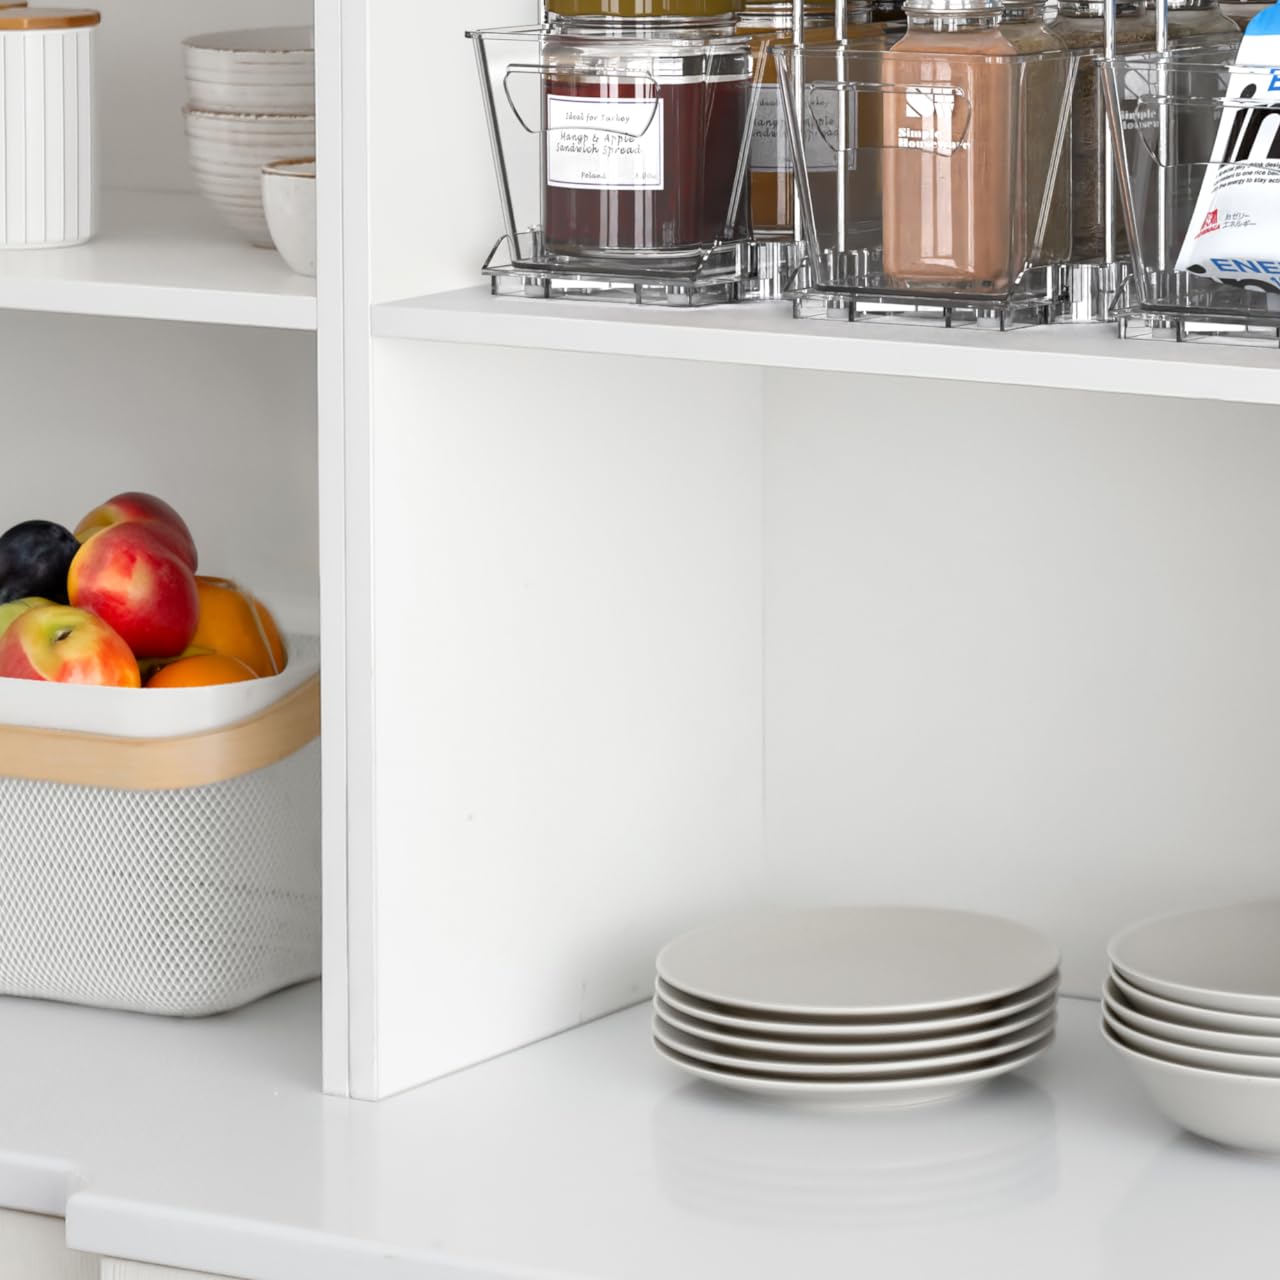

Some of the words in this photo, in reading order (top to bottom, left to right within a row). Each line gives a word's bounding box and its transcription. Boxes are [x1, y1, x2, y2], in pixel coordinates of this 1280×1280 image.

[565, 111, 585, 121] Ideal
[586, 113, 599, 122] for
[602, 144, 642, 158] Spread
